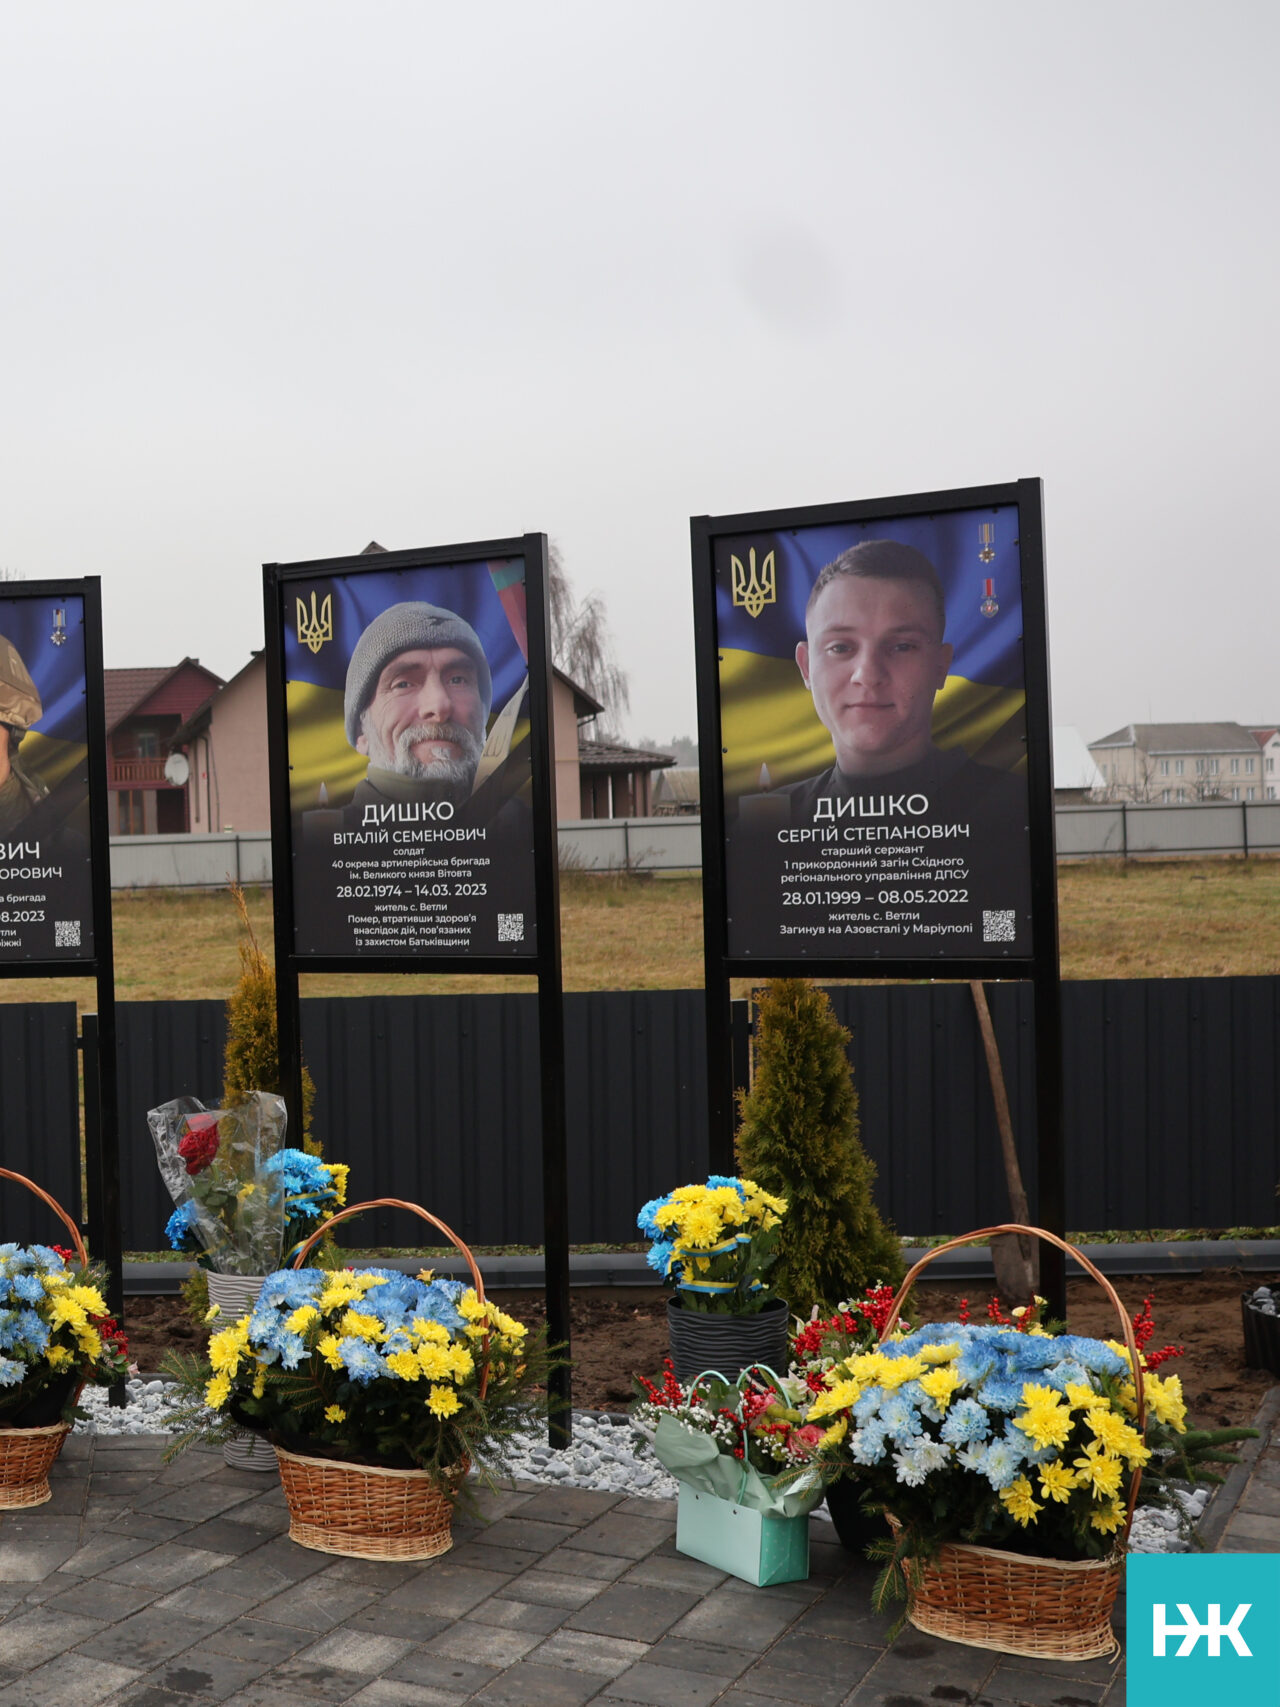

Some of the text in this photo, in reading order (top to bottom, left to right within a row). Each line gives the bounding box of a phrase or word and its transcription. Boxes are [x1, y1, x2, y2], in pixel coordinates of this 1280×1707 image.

[362, 802, 454, 826] ДИШКО
[813, 793, 929, 822] ДИШКО
[334, 828, 486, 845] ВІТАЛІЙ СЕМЕНОВИЧ
[777, 824, 970, 843] СЕРГІЙ СТЕПАНОВИЧ
[393, 848, 425, 856] солдат
[821, 845, 924, 858] старший сержант
[332, 857, 490, 870] 40 окрема артилерійська бригада
[784, 857, 964, 871] 1 прикордонний загін Східного
[350, 869, 472, 880] ім. Великого князя Вітовта
[781, 869, 969, 885] регіонального управління ДПСУ
[336, 885, 402, 898] 28.02.1974
[415, 884, 451, 897] 14.03.
[455, 883, 488, 896] 2023
[782, 891, 861, 905] 28.01.1999
[878, 889, 969, 904] 08.05.2022
[7, 893, 46, 903] бригада
[375, 903, 408, 912] житель
[420, 902, 447, 911] Ветли
[348, 914, 476, 924] Помер, втративши здоров'я
[829, 911, 919, 921] житель с. Ветли
[354, 925, 471, 936] внаслідок дій, пов'язаних
[780, 923, 973, 936] Загинув на Азовсталі у Маріуполі
[356, 937, 470, 947] із захистом Батьківщини
